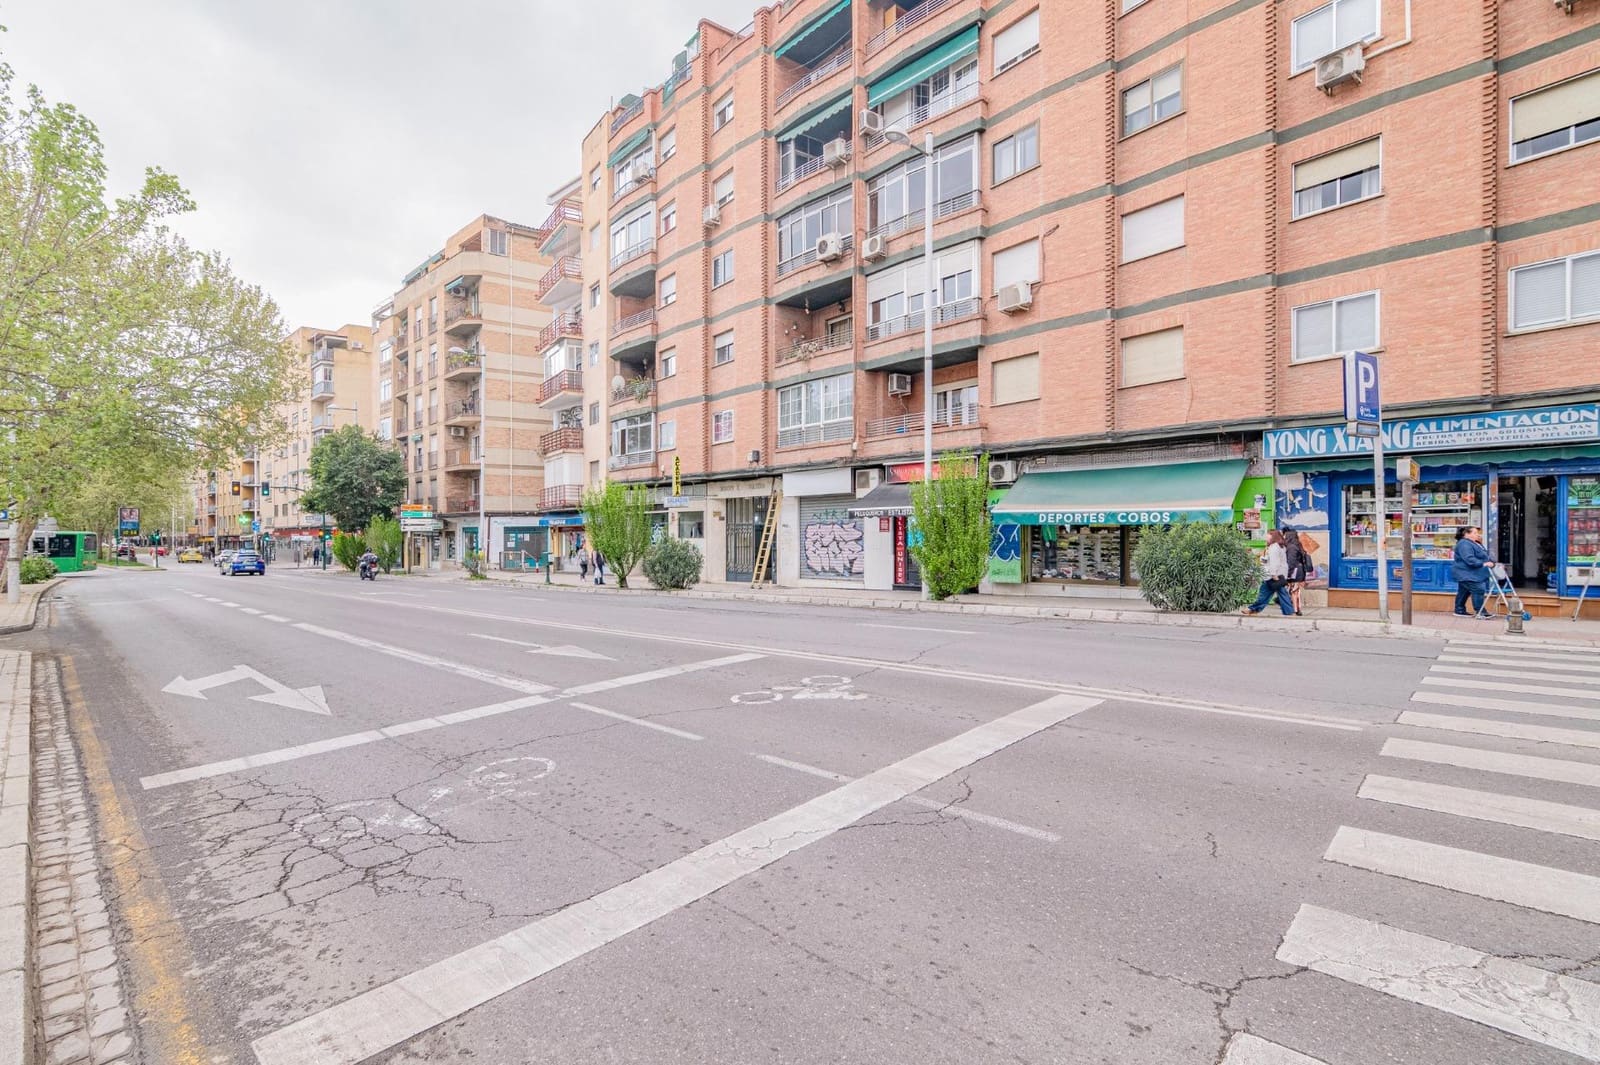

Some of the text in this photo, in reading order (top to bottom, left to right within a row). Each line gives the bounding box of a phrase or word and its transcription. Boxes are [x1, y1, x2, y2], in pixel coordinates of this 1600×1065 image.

[1358, 360, 1375, 403] P
[1414, 407, 1598, 434] ALIMENTACIÓN
[1265, 422, 1410, 457] YONG XIANG
[1416, 433, 1453, 441] FRUTOS
[1498, 426, 1558, 435] GOLOSINAS
[1416, 439, 1457, 447] BEBIDAS
[1541, 430, 1594, 438] HELADOS
[1038, 511, 1171, 524] DEPORTES COBOS
